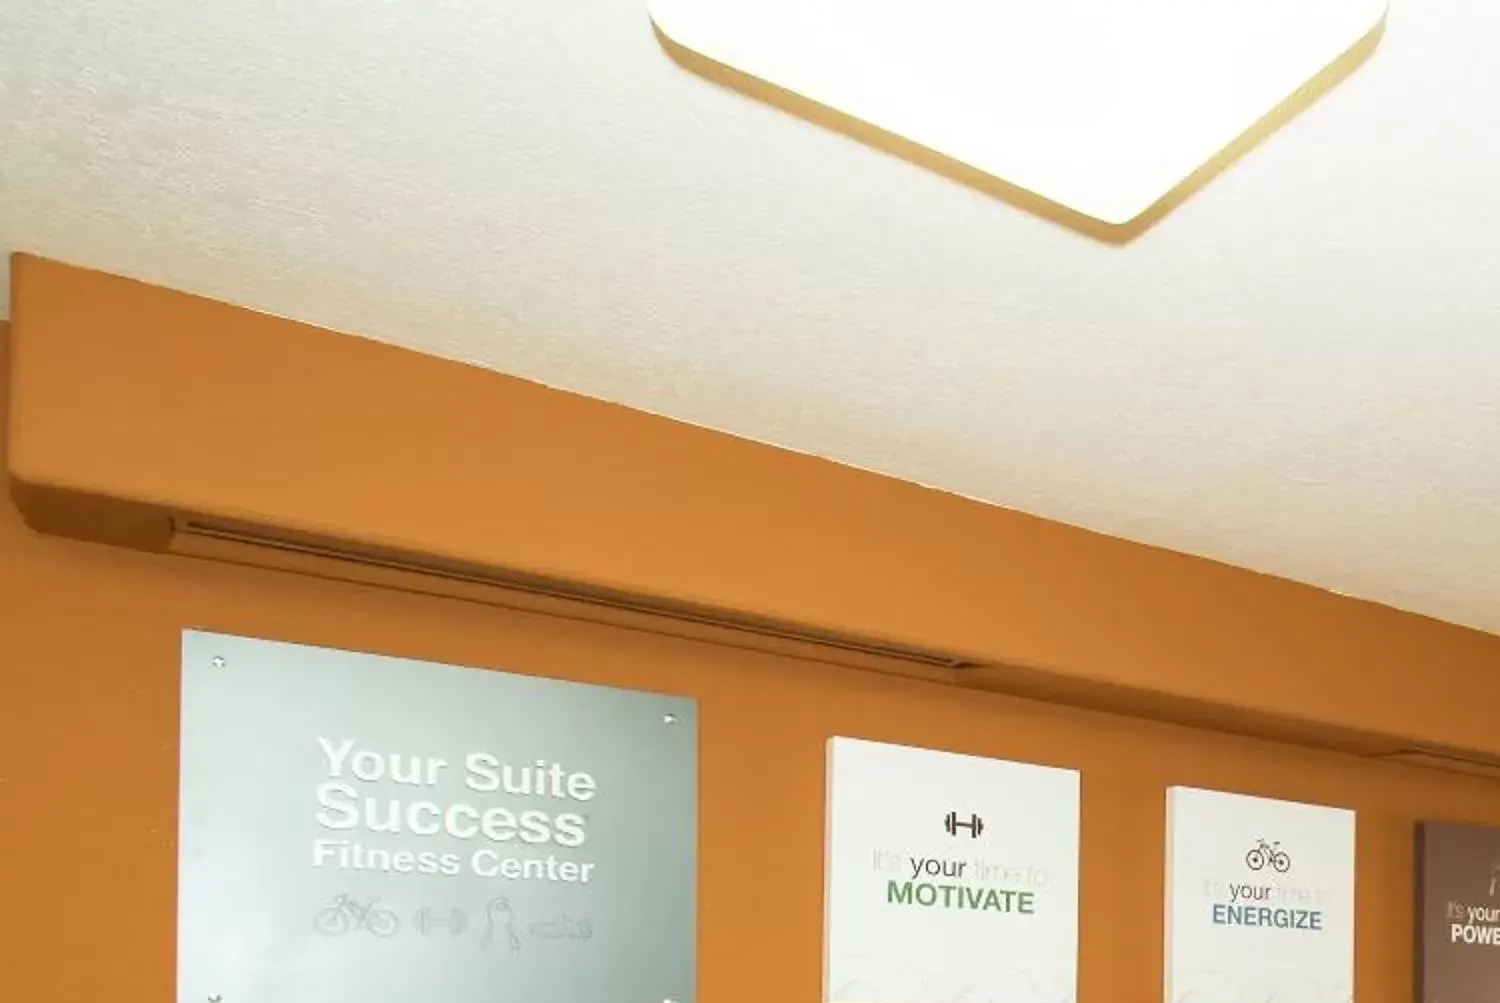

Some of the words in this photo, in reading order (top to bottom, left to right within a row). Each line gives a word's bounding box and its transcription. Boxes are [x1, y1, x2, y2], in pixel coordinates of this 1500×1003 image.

[317, 735, 448, 786] Your
[464, 751, 597, 801] Suite
[314, 780, 587, 848] Success
[311, 838, 461, 876] Fitness
[470, 849, 597, 884] Center
[910, 857, 967, 880] your
[887, 879, 1035, 914] MOTIVATE
[1229, 883, 1272, 903] your
[1212, 903, 1322, 930] ENERGIZE
[1467, 906, 1500, 925] your
